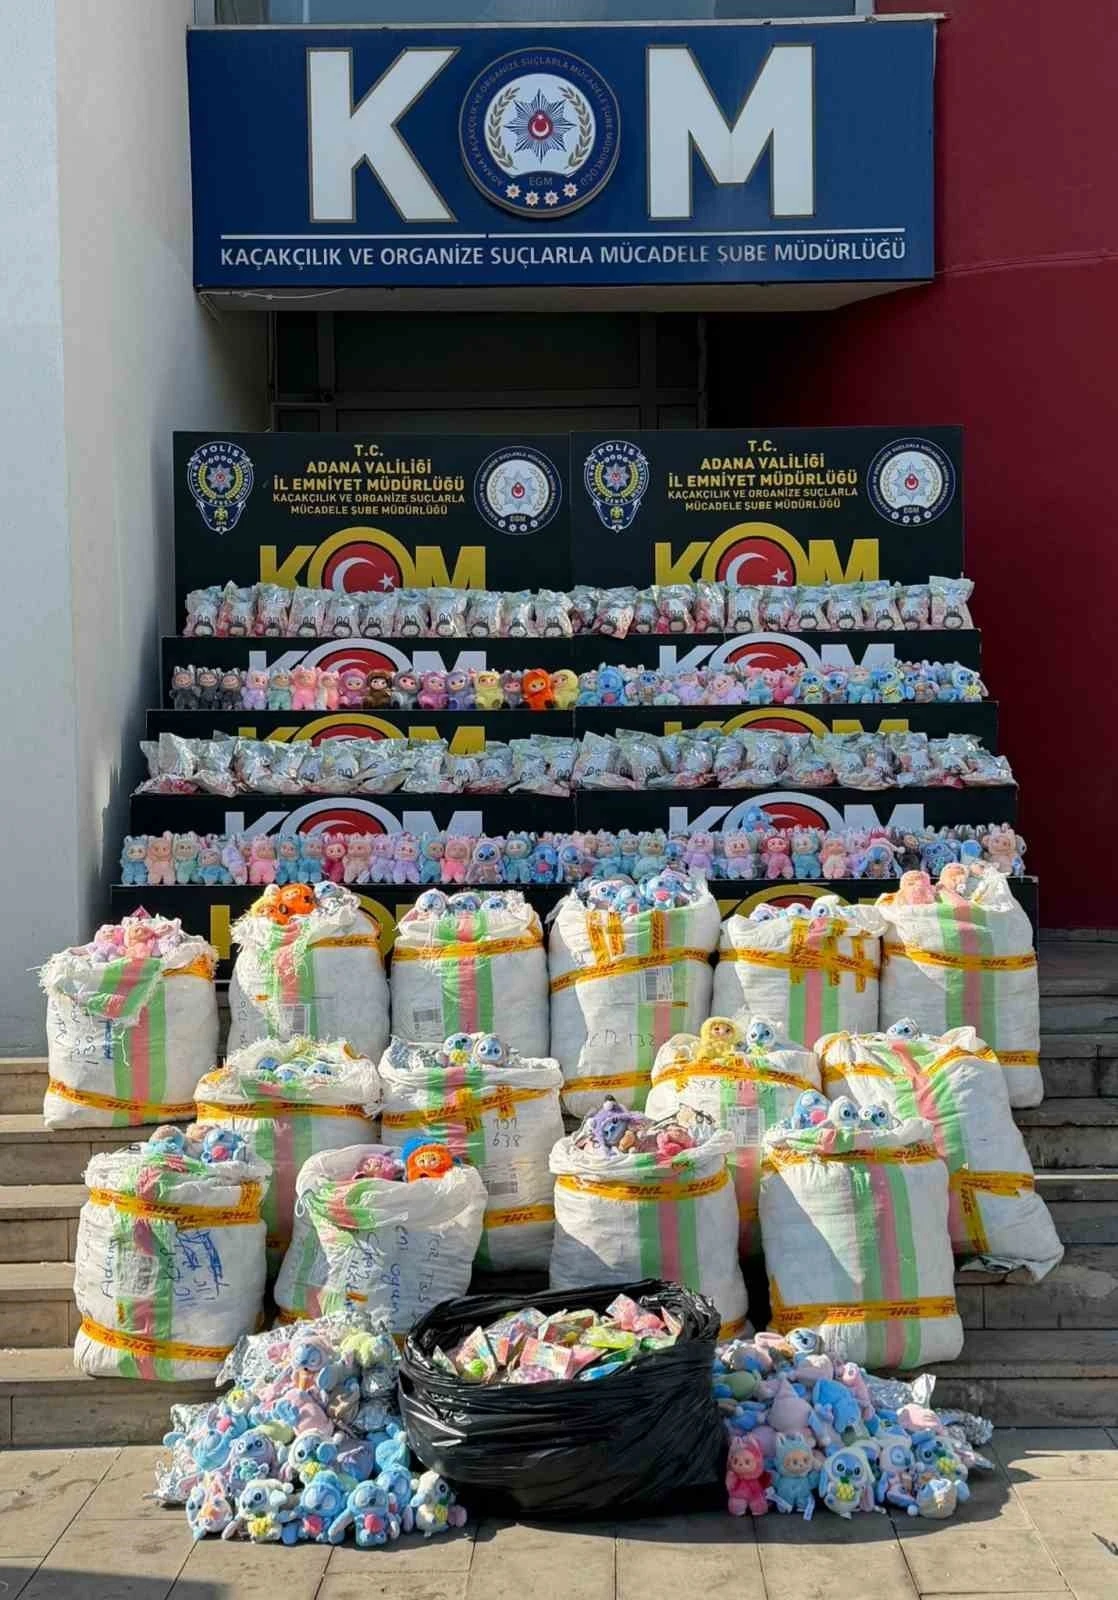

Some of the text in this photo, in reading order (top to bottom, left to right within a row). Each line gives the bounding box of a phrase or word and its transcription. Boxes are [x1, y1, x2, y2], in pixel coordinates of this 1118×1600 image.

[528, 176, 553, 186] EGM
[220, 240, 906, 269] KAÇAKÇILIK VE ORGANİZE SUÇLARLA MÜCADELE ŞUBE MÜDÜRLÜĞÜ
[353, 444, 384, 457] T.C.
[748, 440, 777, 452] T.C.
[307, 458, 432, 474] ADANA VALİLİĞİ
[701, 453, 825, 470] ADANA VALİLİĞİ
[273, 475, 465, 491] İL EMNİYET MÜDÜRLÜĞÜ
[668, 469, 858, 488] İL EMNİYET MÜDÜRLÜĞÜ
[272, 492, 465, 505] KAÇAKÇILIK VE ORGANİZE SUÇLARLA
[668, 486, 858, 501] KAÇAKÇILIK VE ORGANİZE SUÇLARLA
[291, 503, 448, 517] MÜCADELE ŞUBE MÜDÜRLÜĞÜ
[685, 498, 841, 514] MÜCADELE ŞUBE MÜDÜRLÜĞÜ
